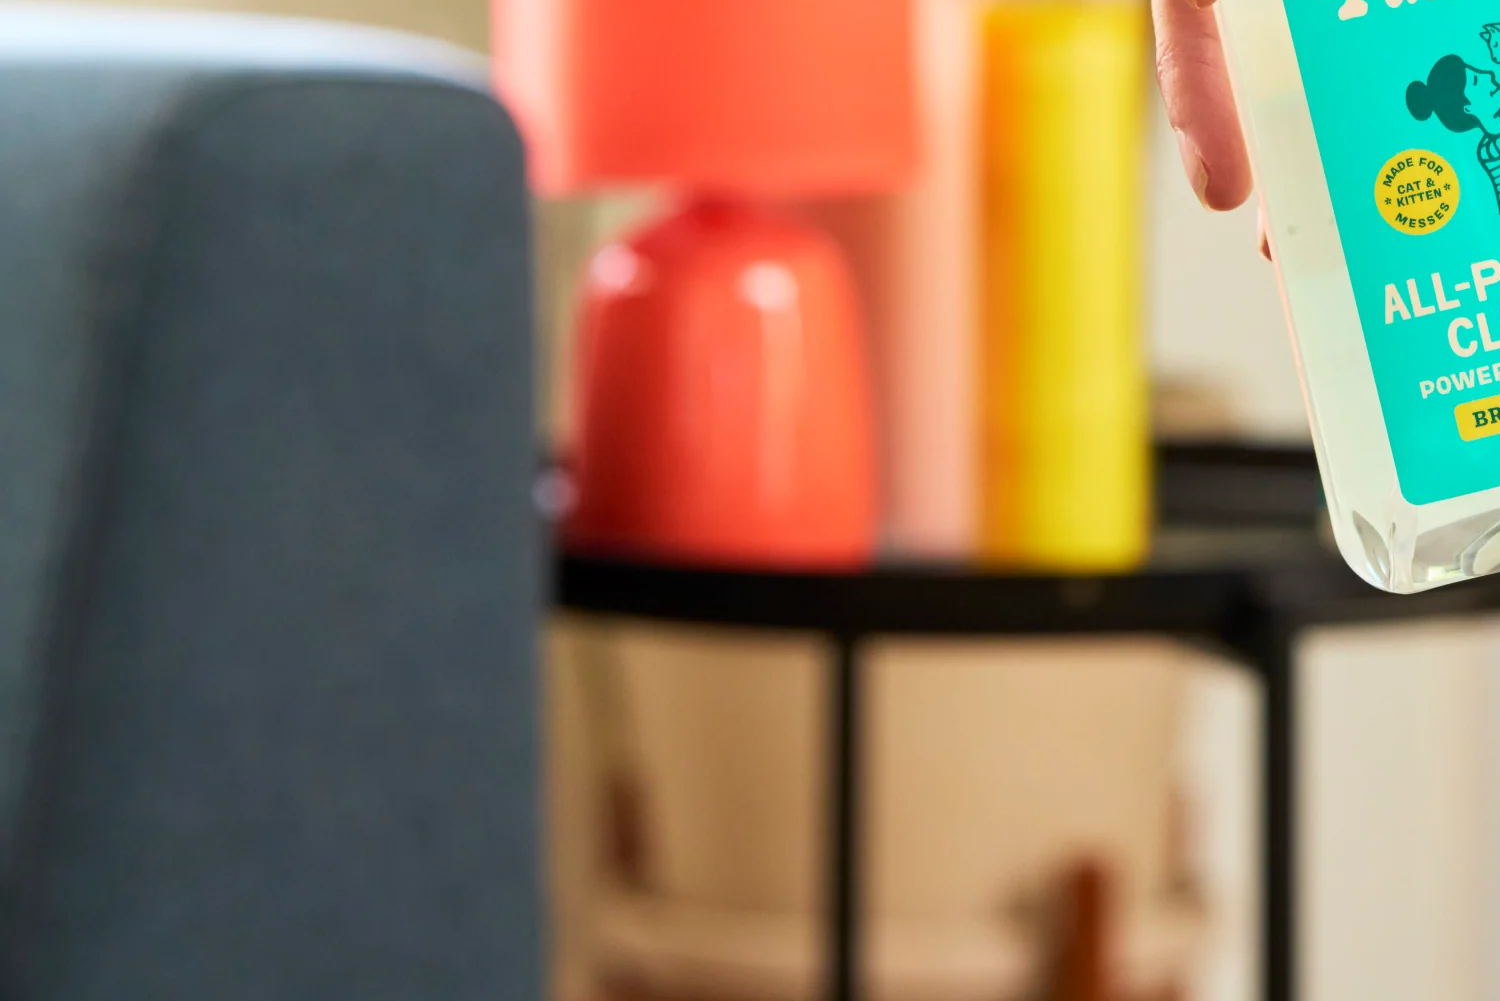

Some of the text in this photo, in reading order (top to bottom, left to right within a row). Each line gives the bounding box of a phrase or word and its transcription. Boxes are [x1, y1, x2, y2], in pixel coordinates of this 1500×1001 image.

[1382, 157, 1444, 187] MADE FOR
[1397, 178, 1435, 194] CAT &
[1396, 188, 1442, 207] KITTEN
[1395, 202, 1450, 228] MESSES
